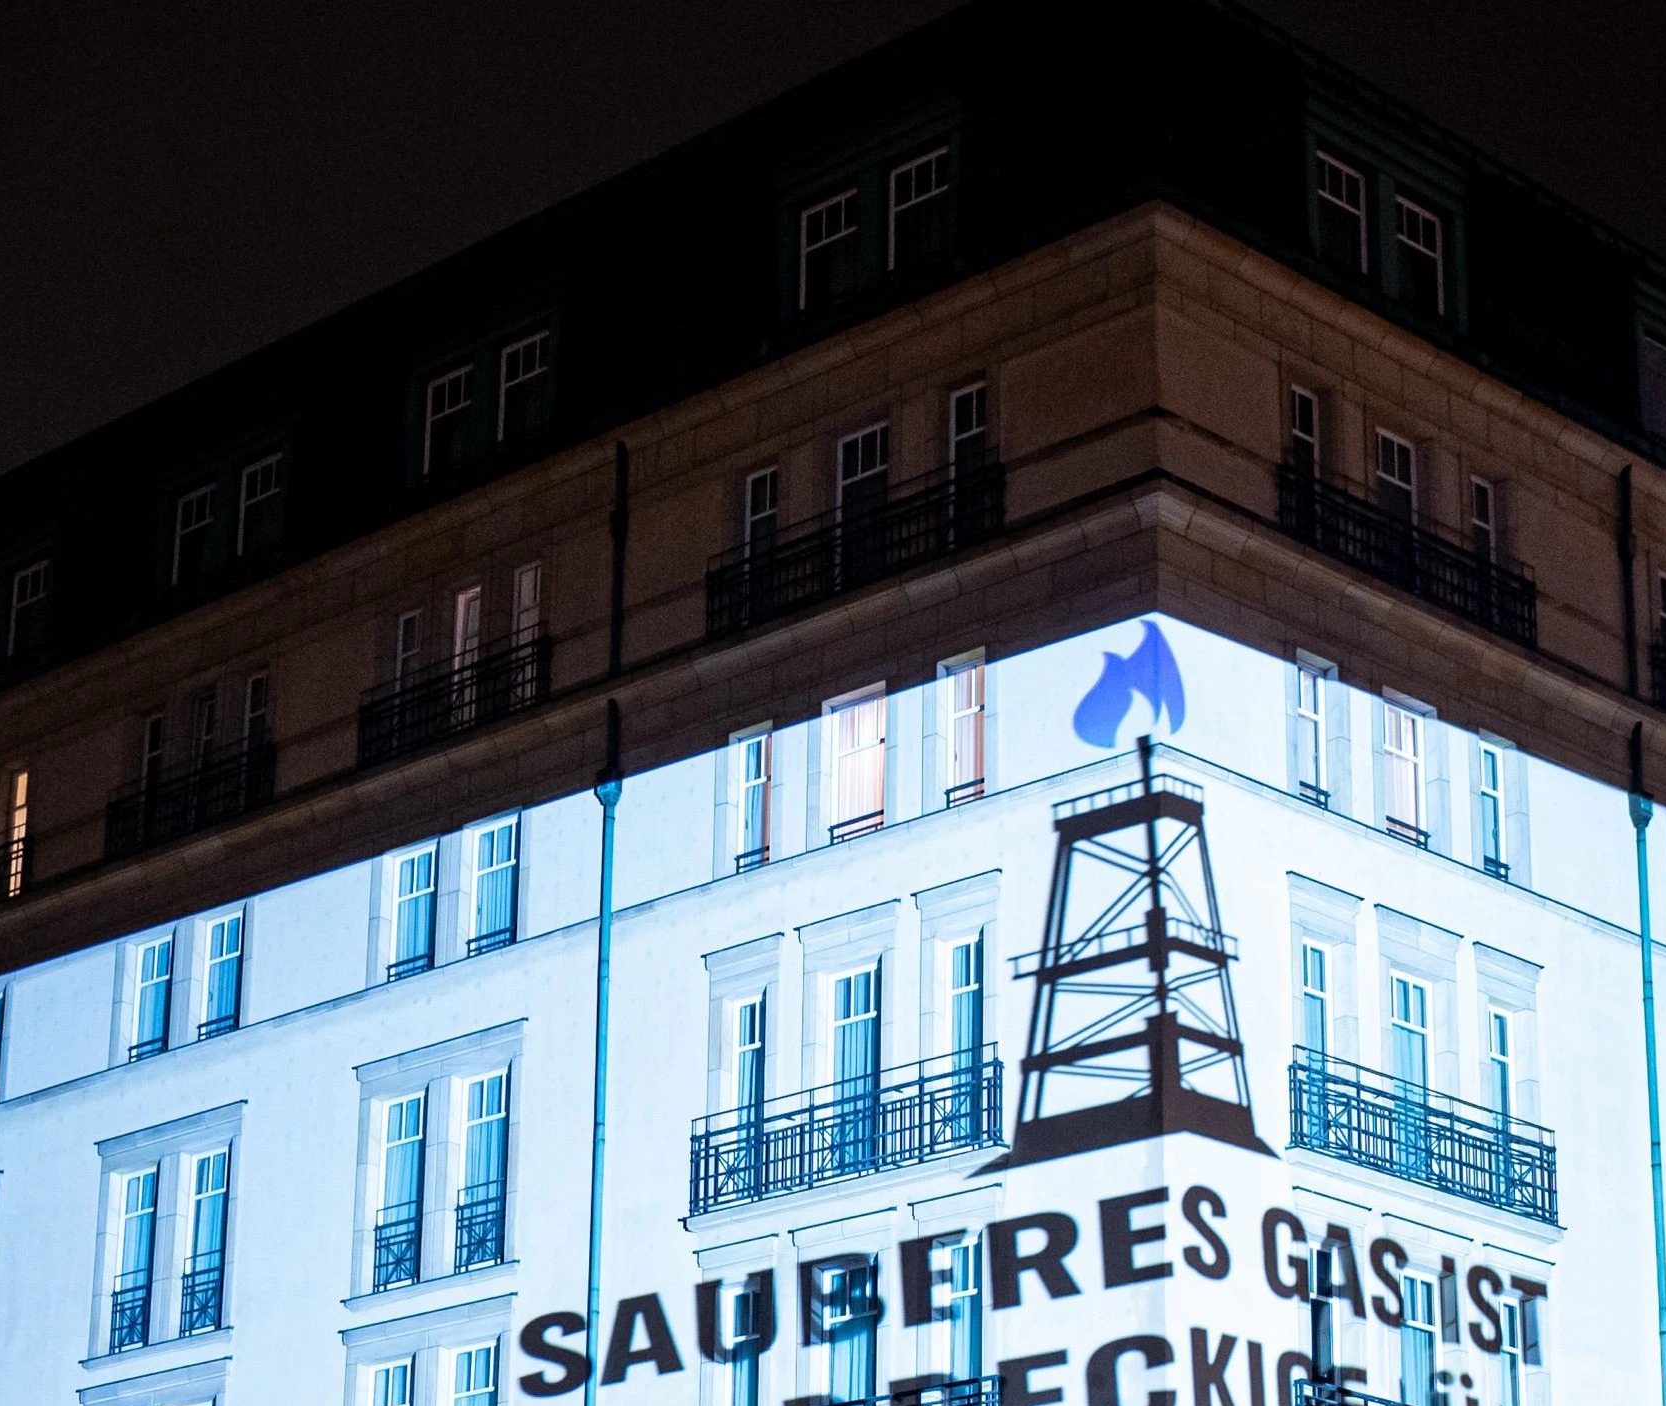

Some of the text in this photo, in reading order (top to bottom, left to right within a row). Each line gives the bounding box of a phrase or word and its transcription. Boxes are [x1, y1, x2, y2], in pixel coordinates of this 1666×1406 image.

[518, 1185, 1549, 1397] SAUBERES GAS IST
